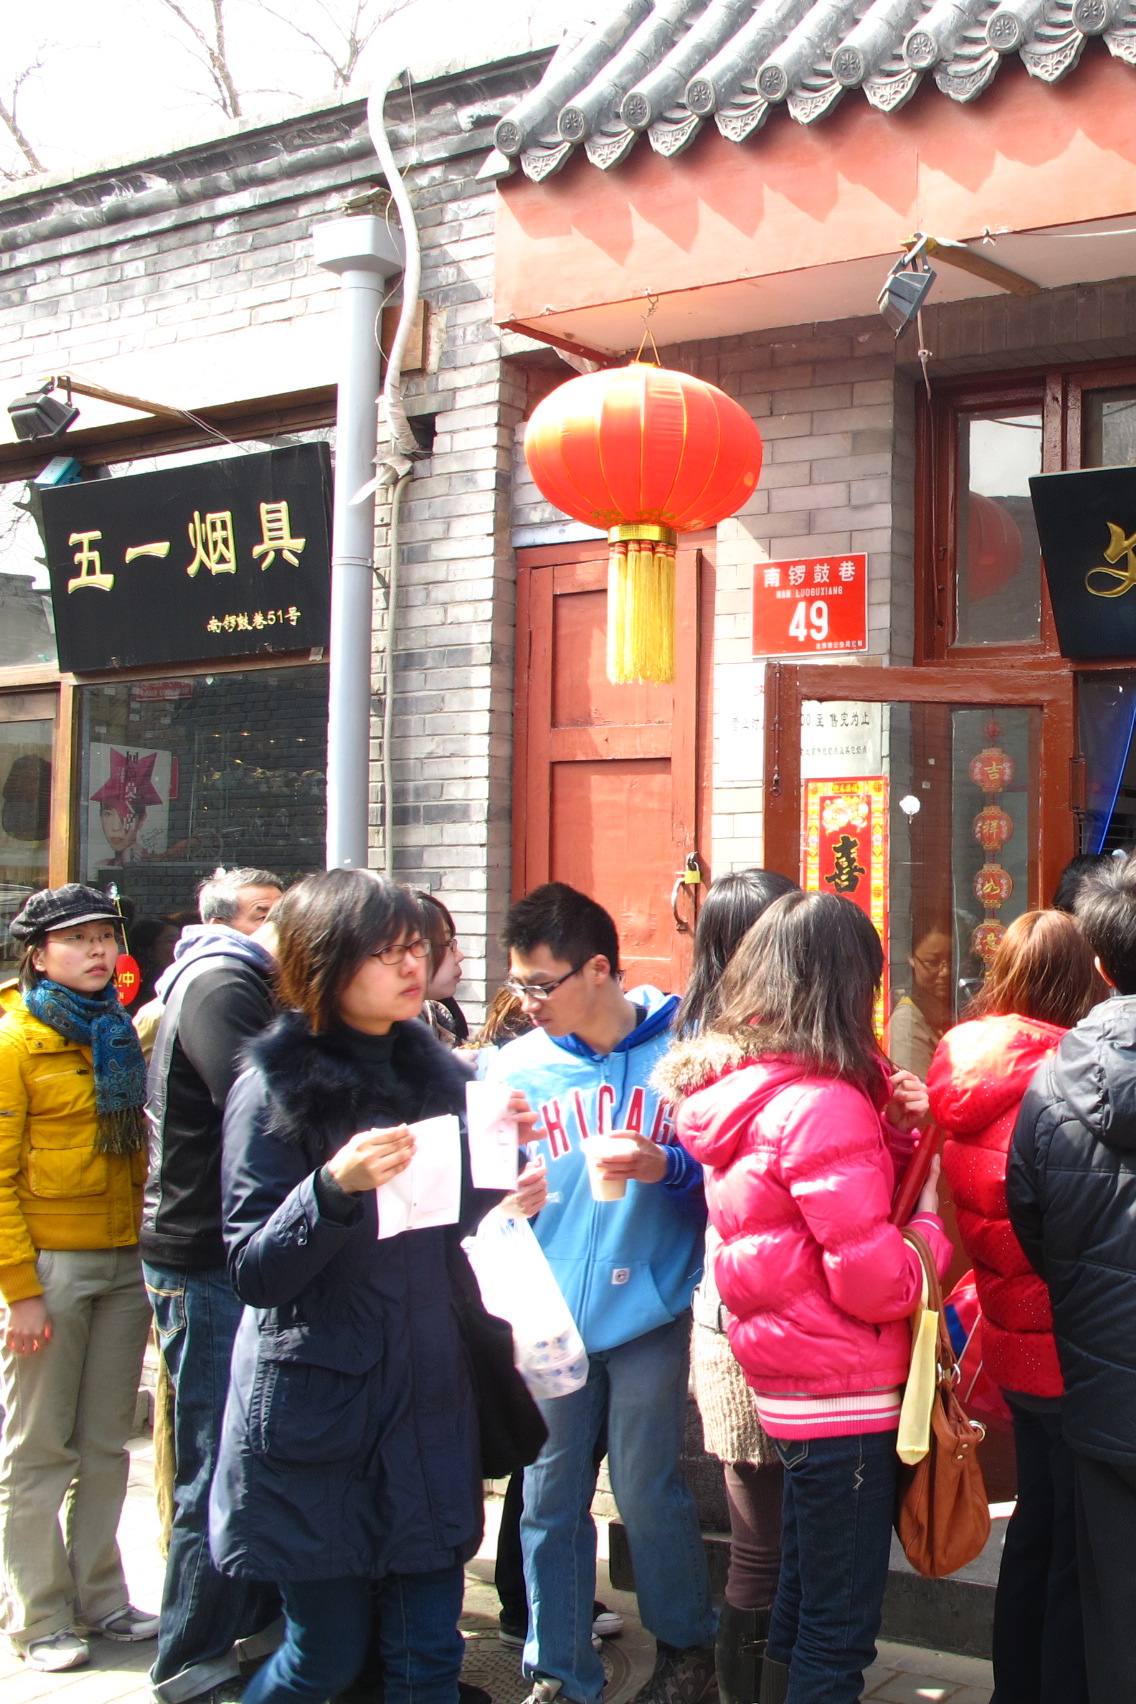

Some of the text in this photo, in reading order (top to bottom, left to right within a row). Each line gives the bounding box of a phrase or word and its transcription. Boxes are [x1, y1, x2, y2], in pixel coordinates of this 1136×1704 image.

[67, 501, 306, 593] 五一烟具
[763, 561, 856, 588] 南锣鼓巷
[207, 607, 301, 633] 南锣鼓巷51号
[788, 600, 829, 642] 49
[825, 834, 866, 893] 喜
[532, 1083, 675, 1166] HICAG
